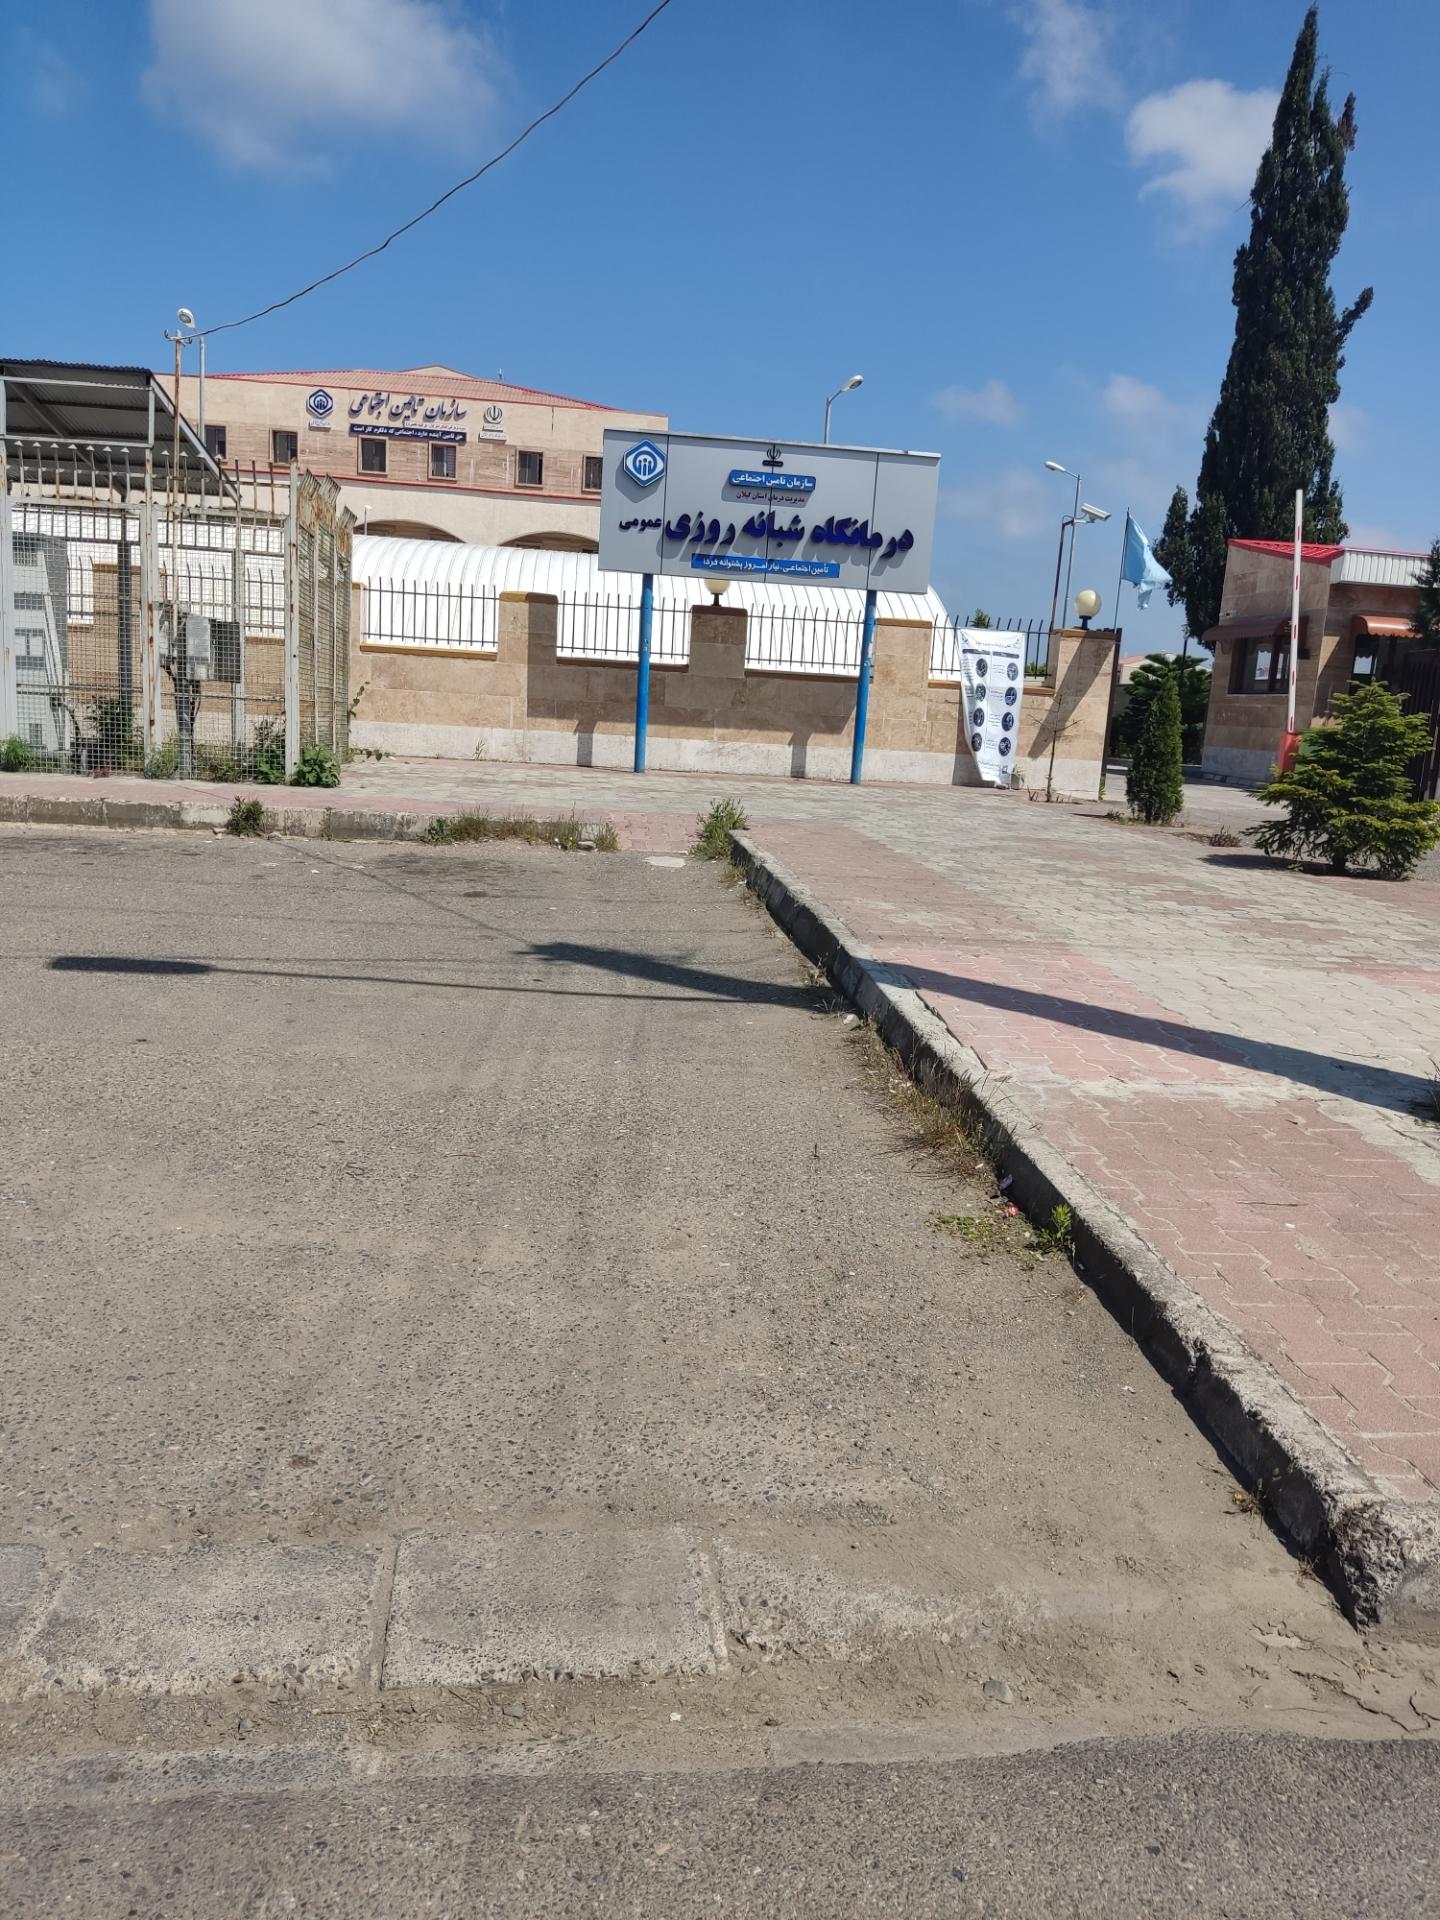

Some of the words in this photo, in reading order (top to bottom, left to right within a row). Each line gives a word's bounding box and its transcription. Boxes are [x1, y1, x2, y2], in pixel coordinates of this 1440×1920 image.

[732, 472, 766, 483] اجتماعی
[786, 477, 814, 488] سازمان
[618, 517, 663, 532] عمومی
[810, 515, 914, 560] درمانگاه
